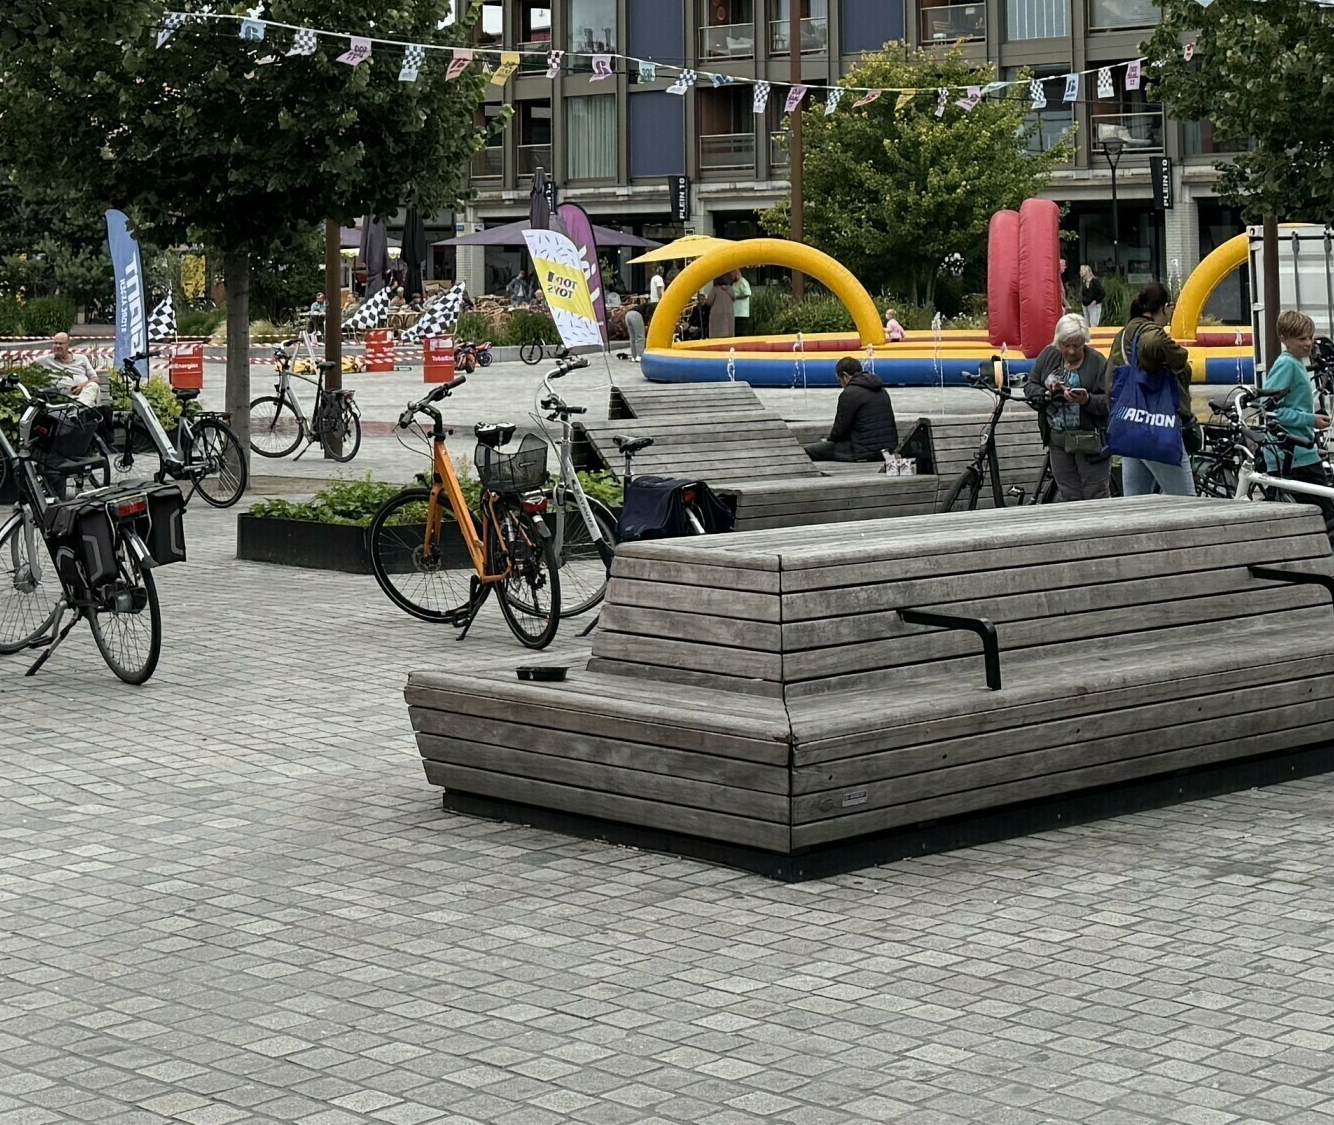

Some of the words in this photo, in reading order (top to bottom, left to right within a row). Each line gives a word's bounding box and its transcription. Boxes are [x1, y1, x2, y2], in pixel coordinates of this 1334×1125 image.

[1162, 159, 1168, 172] 10
[679, 177, 685, 189] 10
[1123, 407, 1176, 428] ACTION
